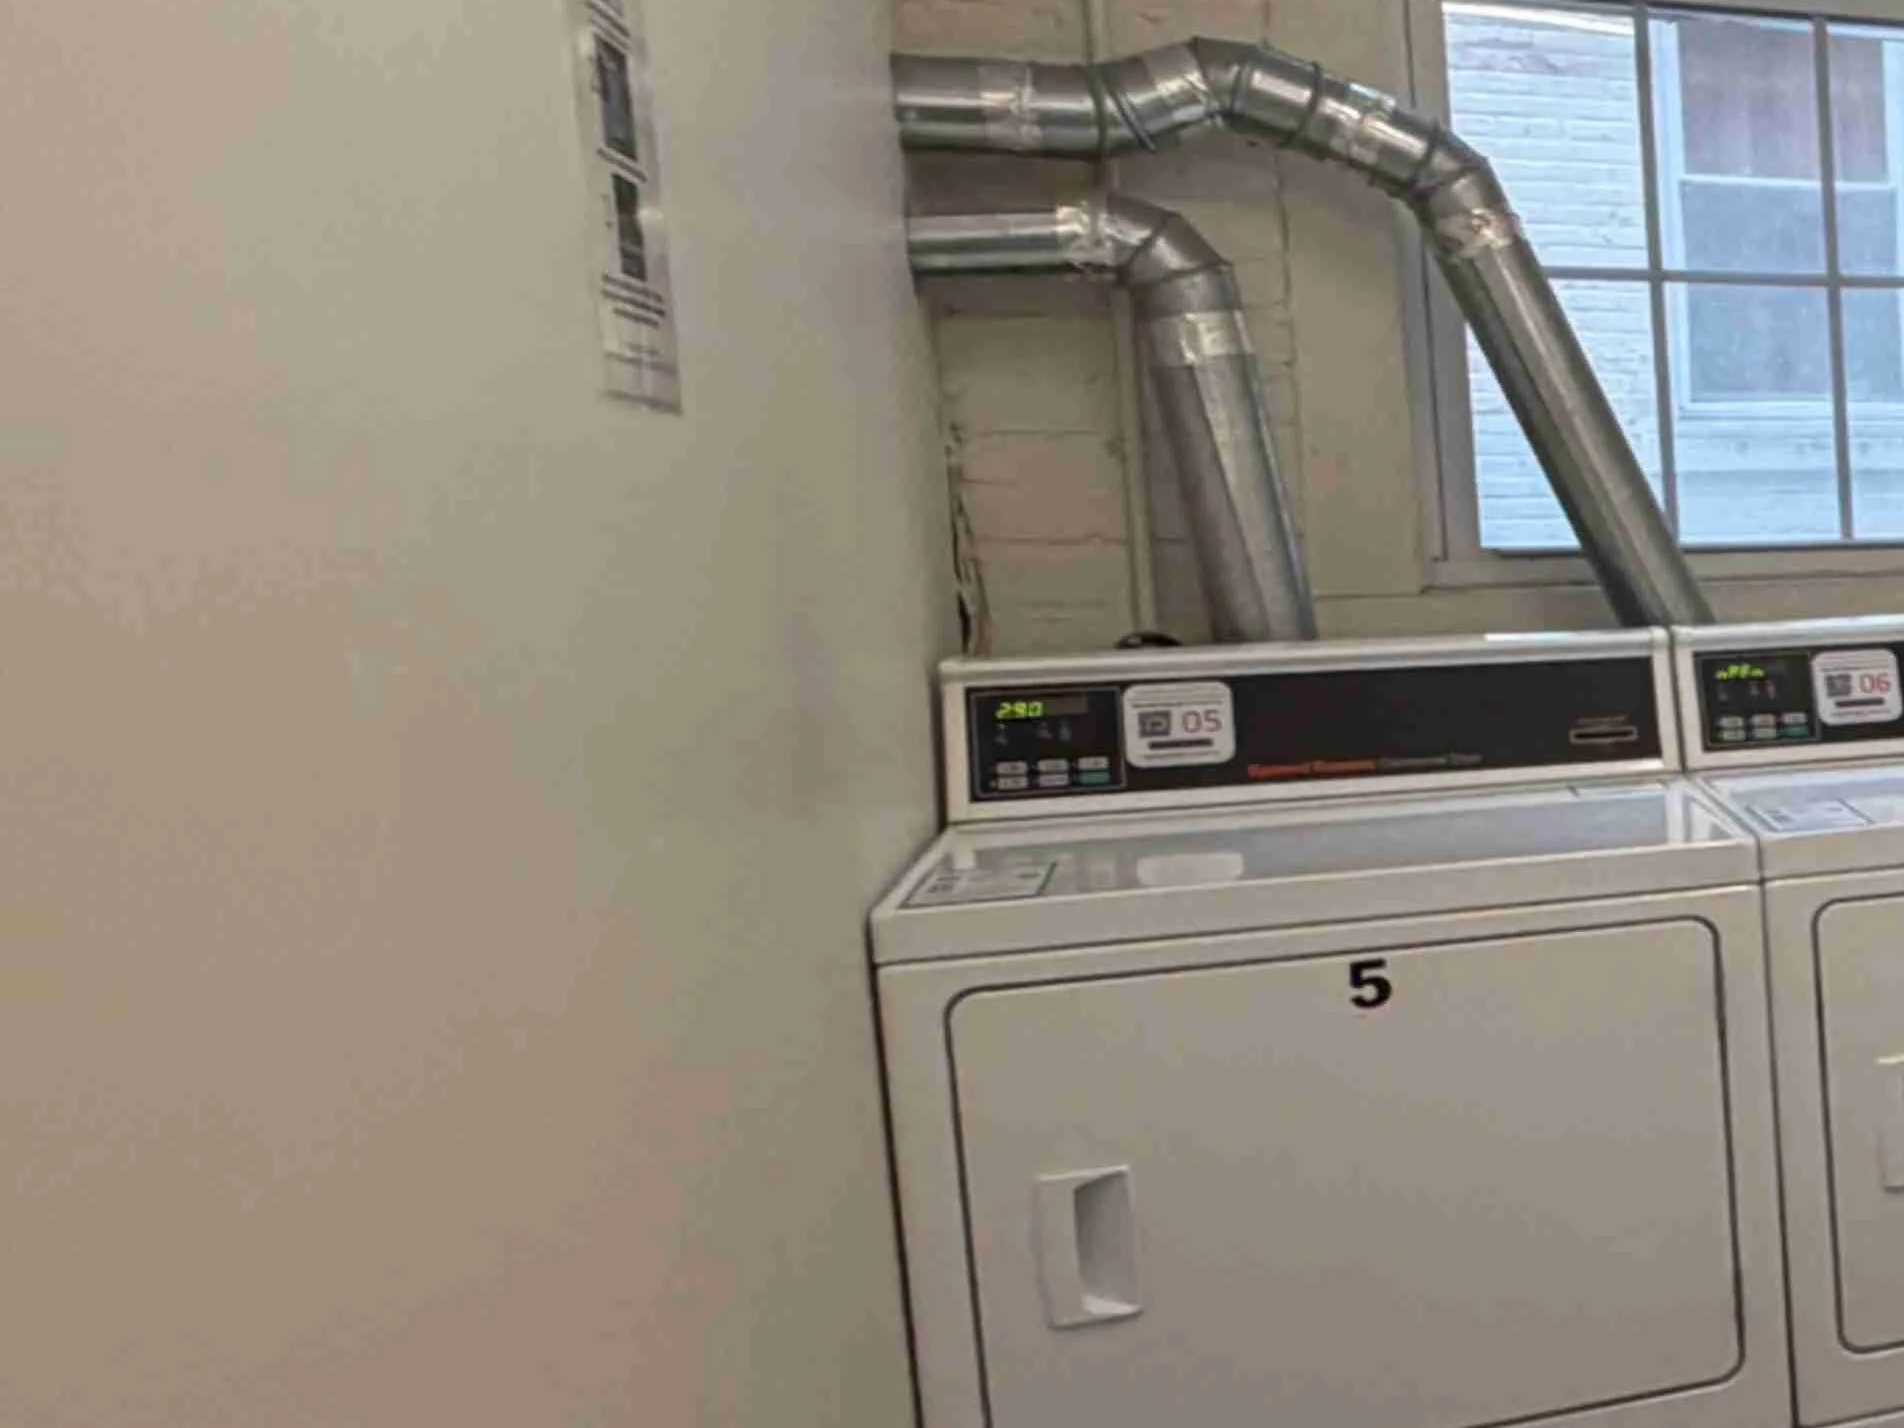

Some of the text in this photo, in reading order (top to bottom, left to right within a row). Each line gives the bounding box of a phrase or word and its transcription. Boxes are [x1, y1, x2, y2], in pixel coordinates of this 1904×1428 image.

[1859, 673, 1891, 694] 06
[1181, 709, 1222, 734] 05
[1349, 958, 1392, 1009] 5
